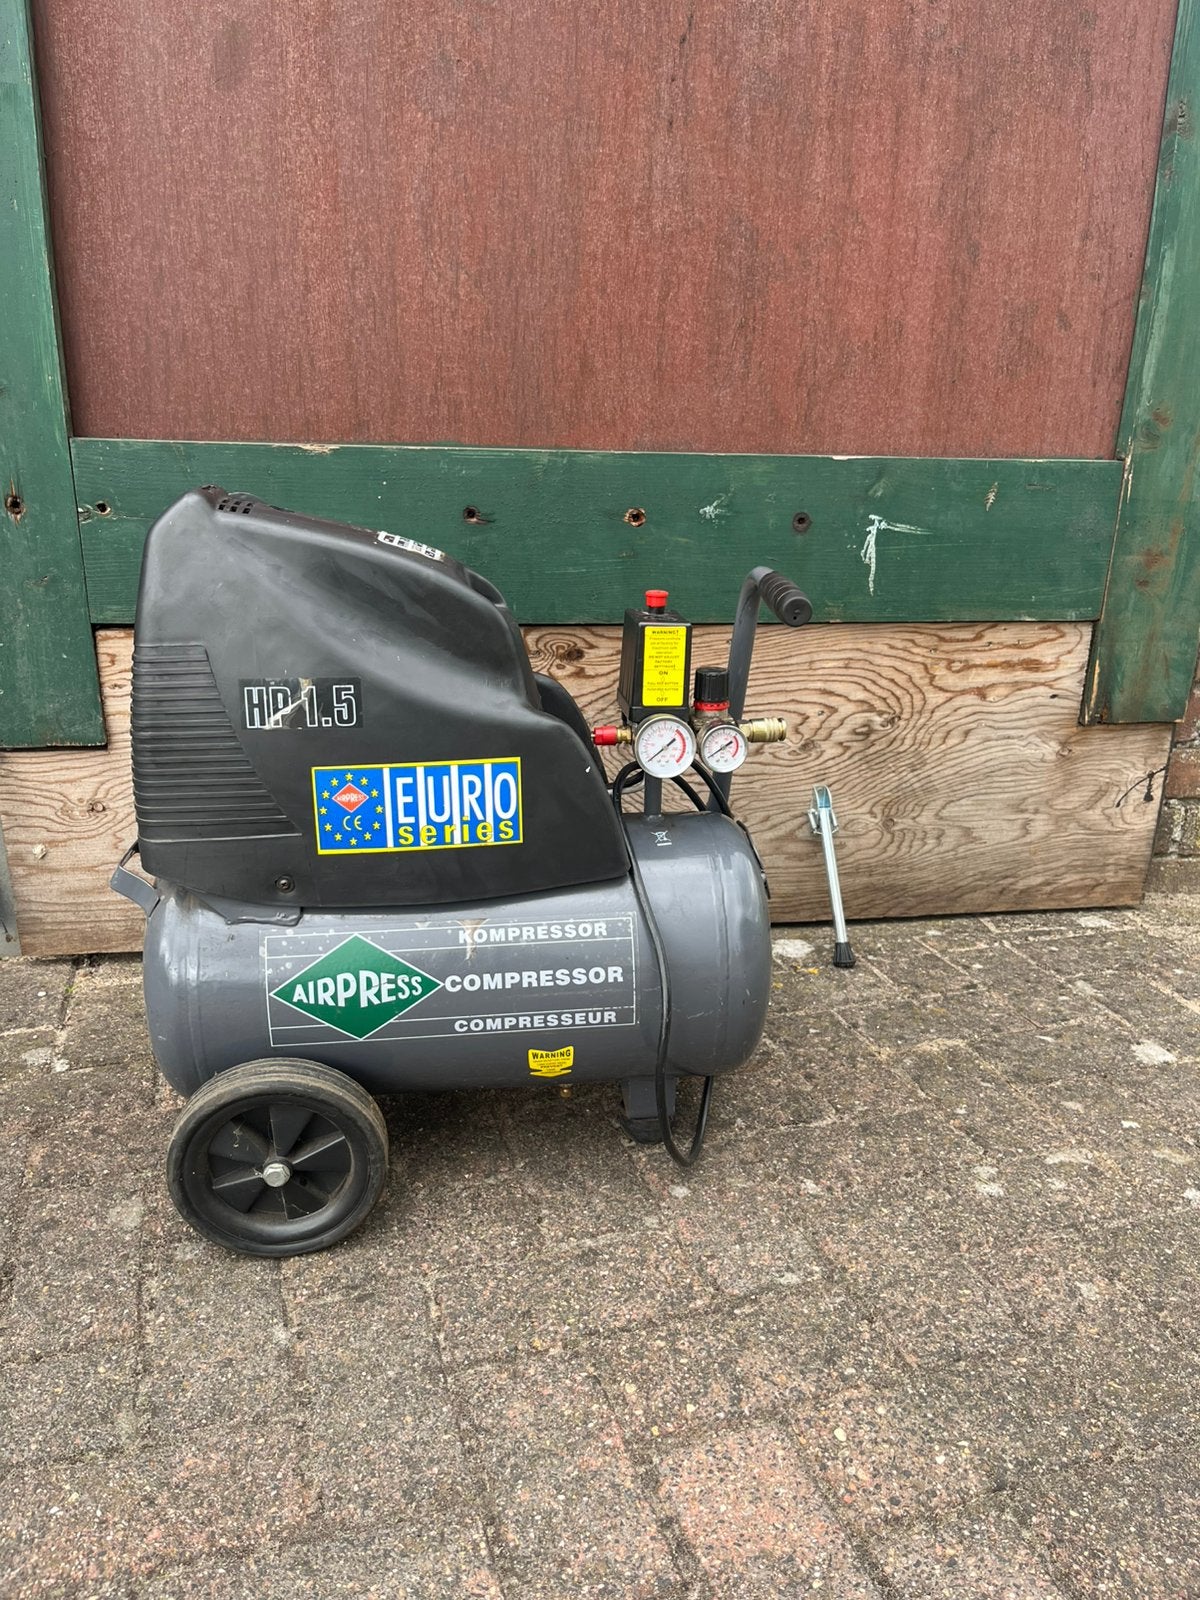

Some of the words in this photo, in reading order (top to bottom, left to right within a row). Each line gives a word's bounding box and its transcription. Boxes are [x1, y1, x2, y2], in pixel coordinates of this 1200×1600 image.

[244, 686, 291, 729] HP
[301, 685, 357, 728] 1.5
[396, 772, 518, 824] EURO
[343, 815, 363, 831] CE
[398, 816, 515, 845] series
[458, 922, 607, 944] KOMPRESSOR
[292, 970, 423, 1008] AIRPRESS
[445, 966, 624, 993] COMPRESSOR
[454, 1011, 617, 1032] COMPRESSEUR
[531, 1049, 571, 1060] WARNING
